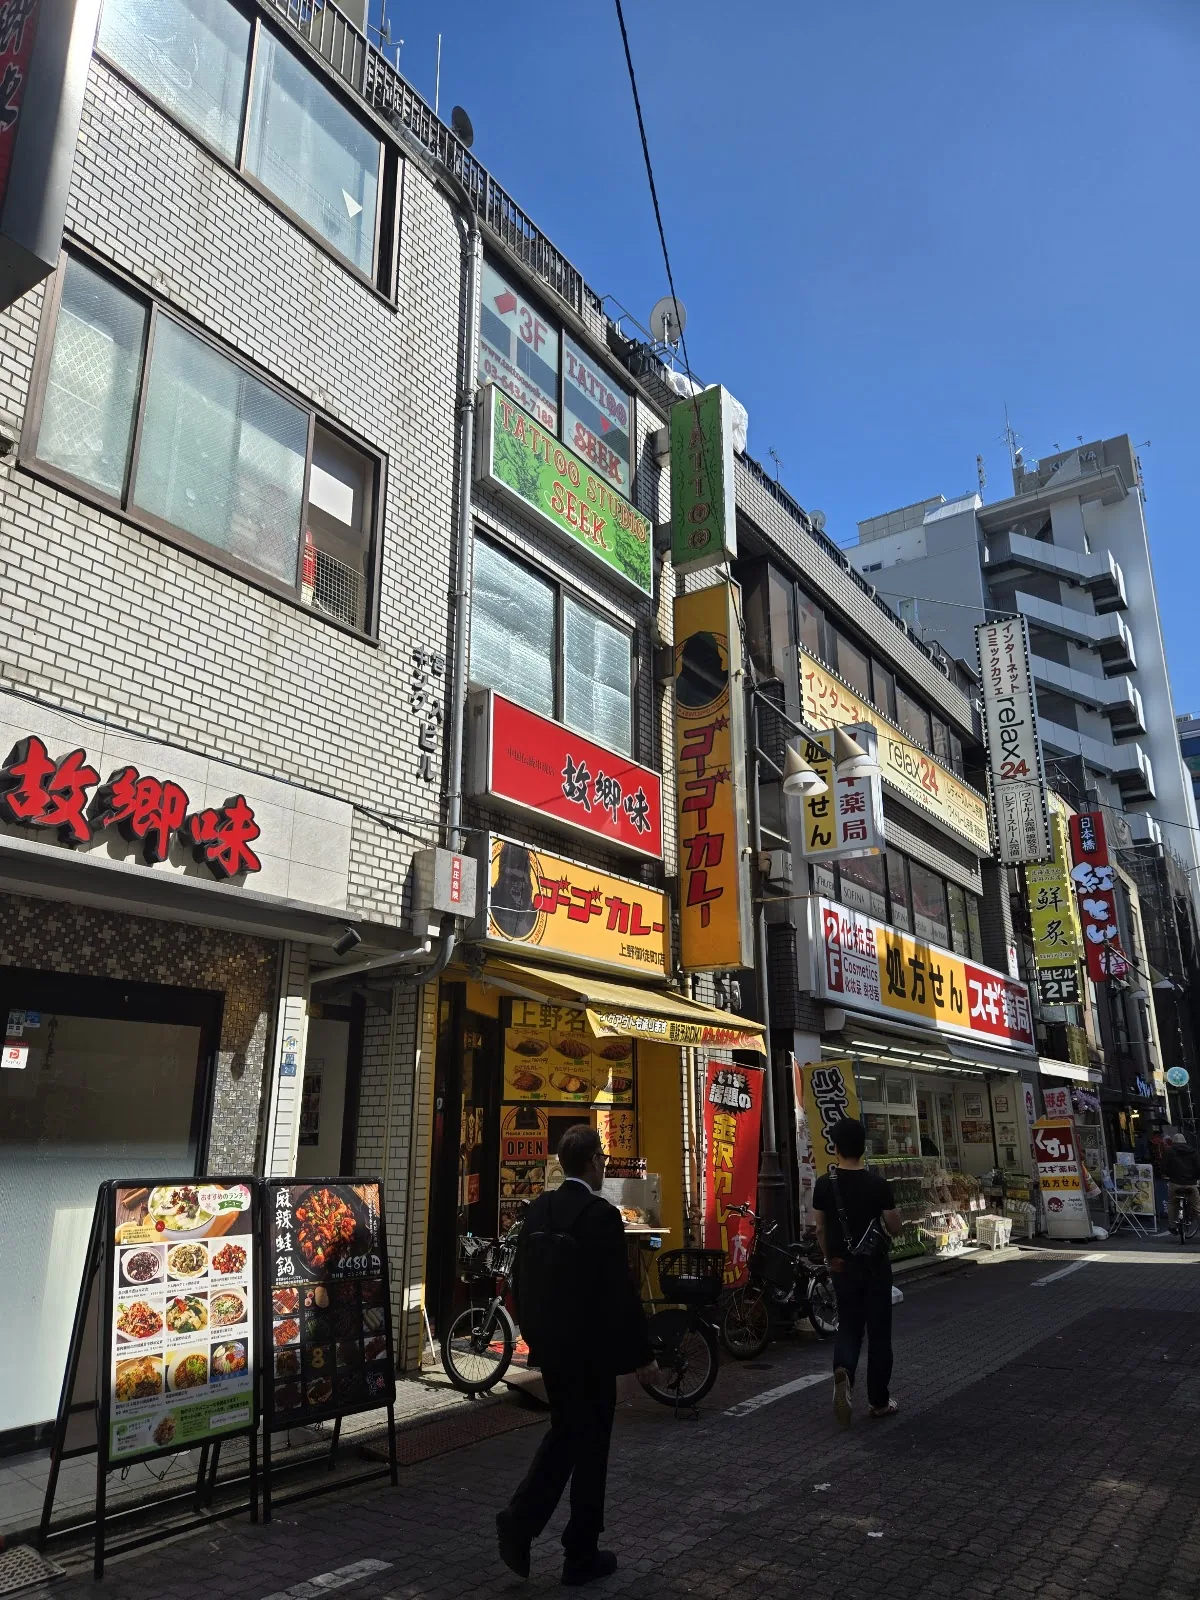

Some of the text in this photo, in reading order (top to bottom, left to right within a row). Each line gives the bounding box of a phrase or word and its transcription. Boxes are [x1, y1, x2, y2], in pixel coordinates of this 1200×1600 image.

[519, 305, 548, 354] 3F
[484, 358, 554, 429] 03-6434-7188
[566, 350, 628, 426] TATTOO
[499, 399, 647, 544] TATTOO STUDIO
[573, 420, 624, 486] SEEK
[687, 400, 712, 550] TATTOO
[547, 480, 610, 551] SEEK
[986, 626, 1004, 696] コミックカフェ
[1001, 622, 1020, 694] インターネット
[3, 735, 262, 878] 故郷味
[561, 753, 652, 835] 故郷味
[680, 715, 731, 928] ゴーゴーカレー
[1005, 795, 1020, 857] レディースルーム完備
[1080, 817, 1097, 851] 日本橋
[534, 872, 666, 937] ゴーゴーカレー
[843, 886, 864, 903] SOFINA
[618, 942, 666, 967] 上野御徒町店
[825, 915, 841, 992] 2F
[839, 917, 877, 960] 化粧品
[843, 955, 878, 983] Cosmetics
[863, 981, 880, 1002] 화장품
[885, 942, 963, 1015] 処方せん
[1041, 968, 1075, 981] 当ビル
[1045, 981, 1074, 998] 2F
[968, 978, 1031, 1035] スギ薬局
[708, 1083, 752, 1110] 話題の
[717, 1070, 746, 1087] いま
[507, 1141, 544, 1156] OPEN
[604, 1112, 618, 1148] 元気
[1035, 1129, 1074, 1162] くすり
[1039, 1164, 1077, 1174] スギ薬局
[1042, 1177, 1080, 1188] 処方せん
[201, 1192, 243, 1201] おすすめのランチ
[275, 1187, 295, 1277] 麻辣蛙鍋
